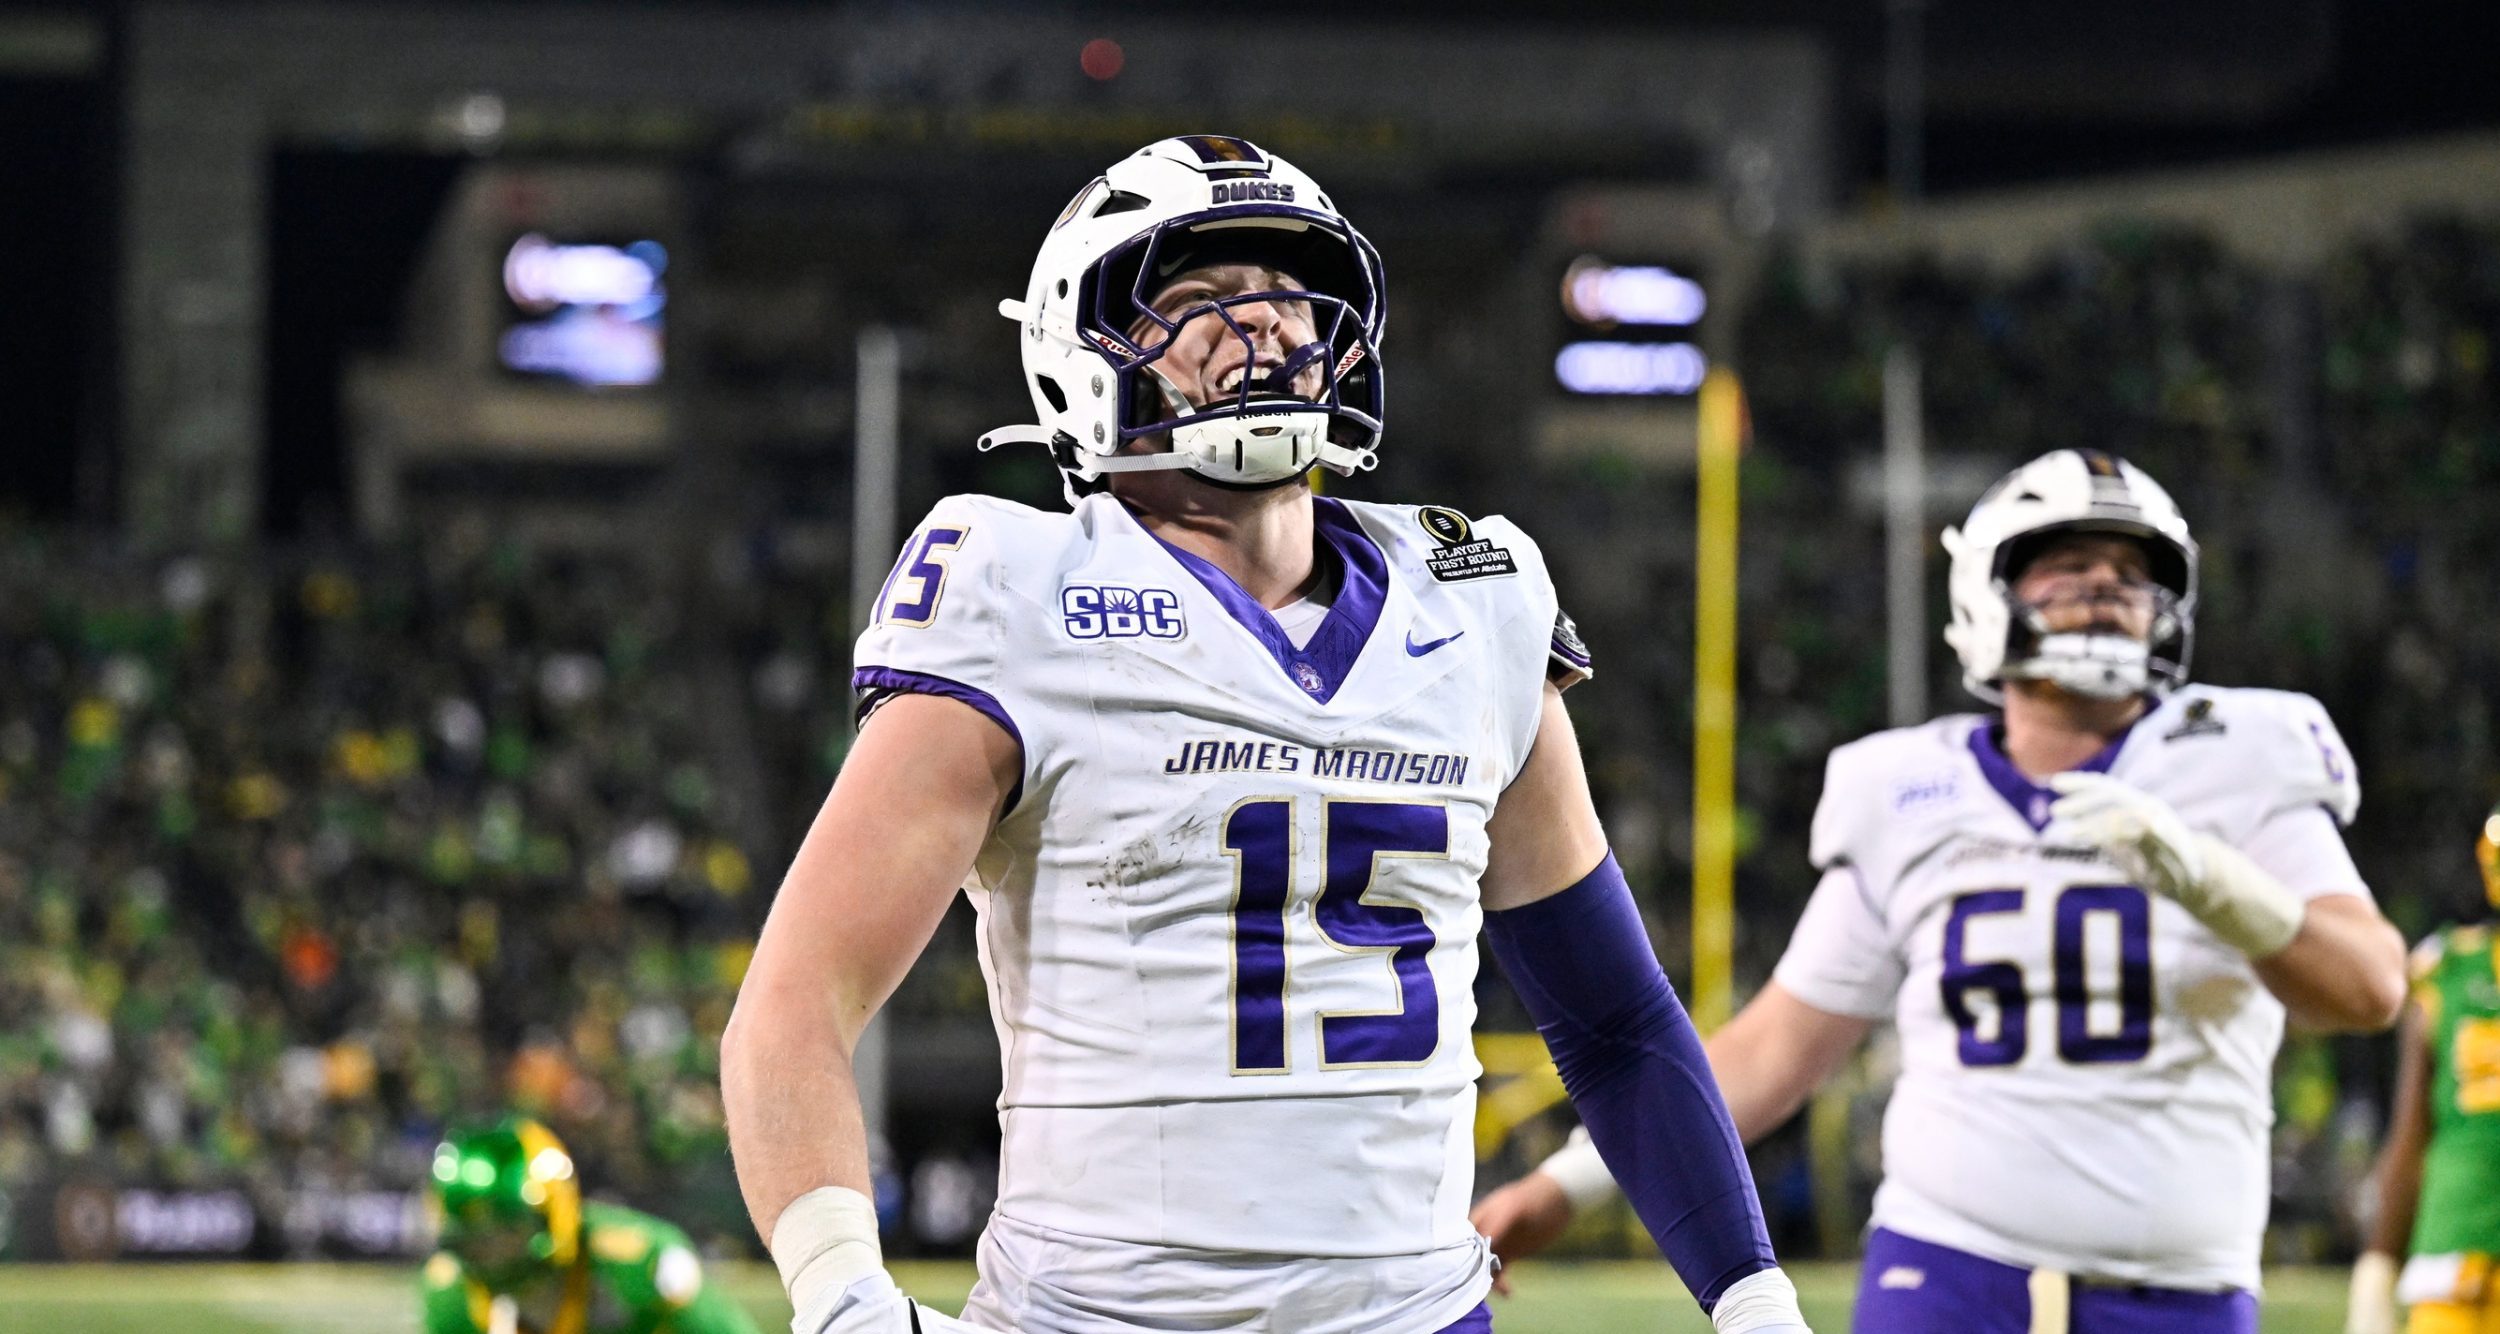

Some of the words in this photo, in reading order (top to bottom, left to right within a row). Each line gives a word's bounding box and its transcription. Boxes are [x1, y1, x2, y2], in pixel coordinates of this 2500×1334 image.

[1212, 181, 1295, 204] DUKES
[1428, 557, 1465, 571] FIRST
[1466, 550, 1509, 565] ROUND
[1435, 541, 1489, 559] PLAYOFF
[875, 524, 971, 630] 15
[1061, 585, 1183, 639] SBC
[1163, 740, 1300, 776] JAMES
[1311, 746, 1471, 787] MADISON
[1220, 793, 1453, 1077] 15
[1940, 882, 2154, 1068] 60
